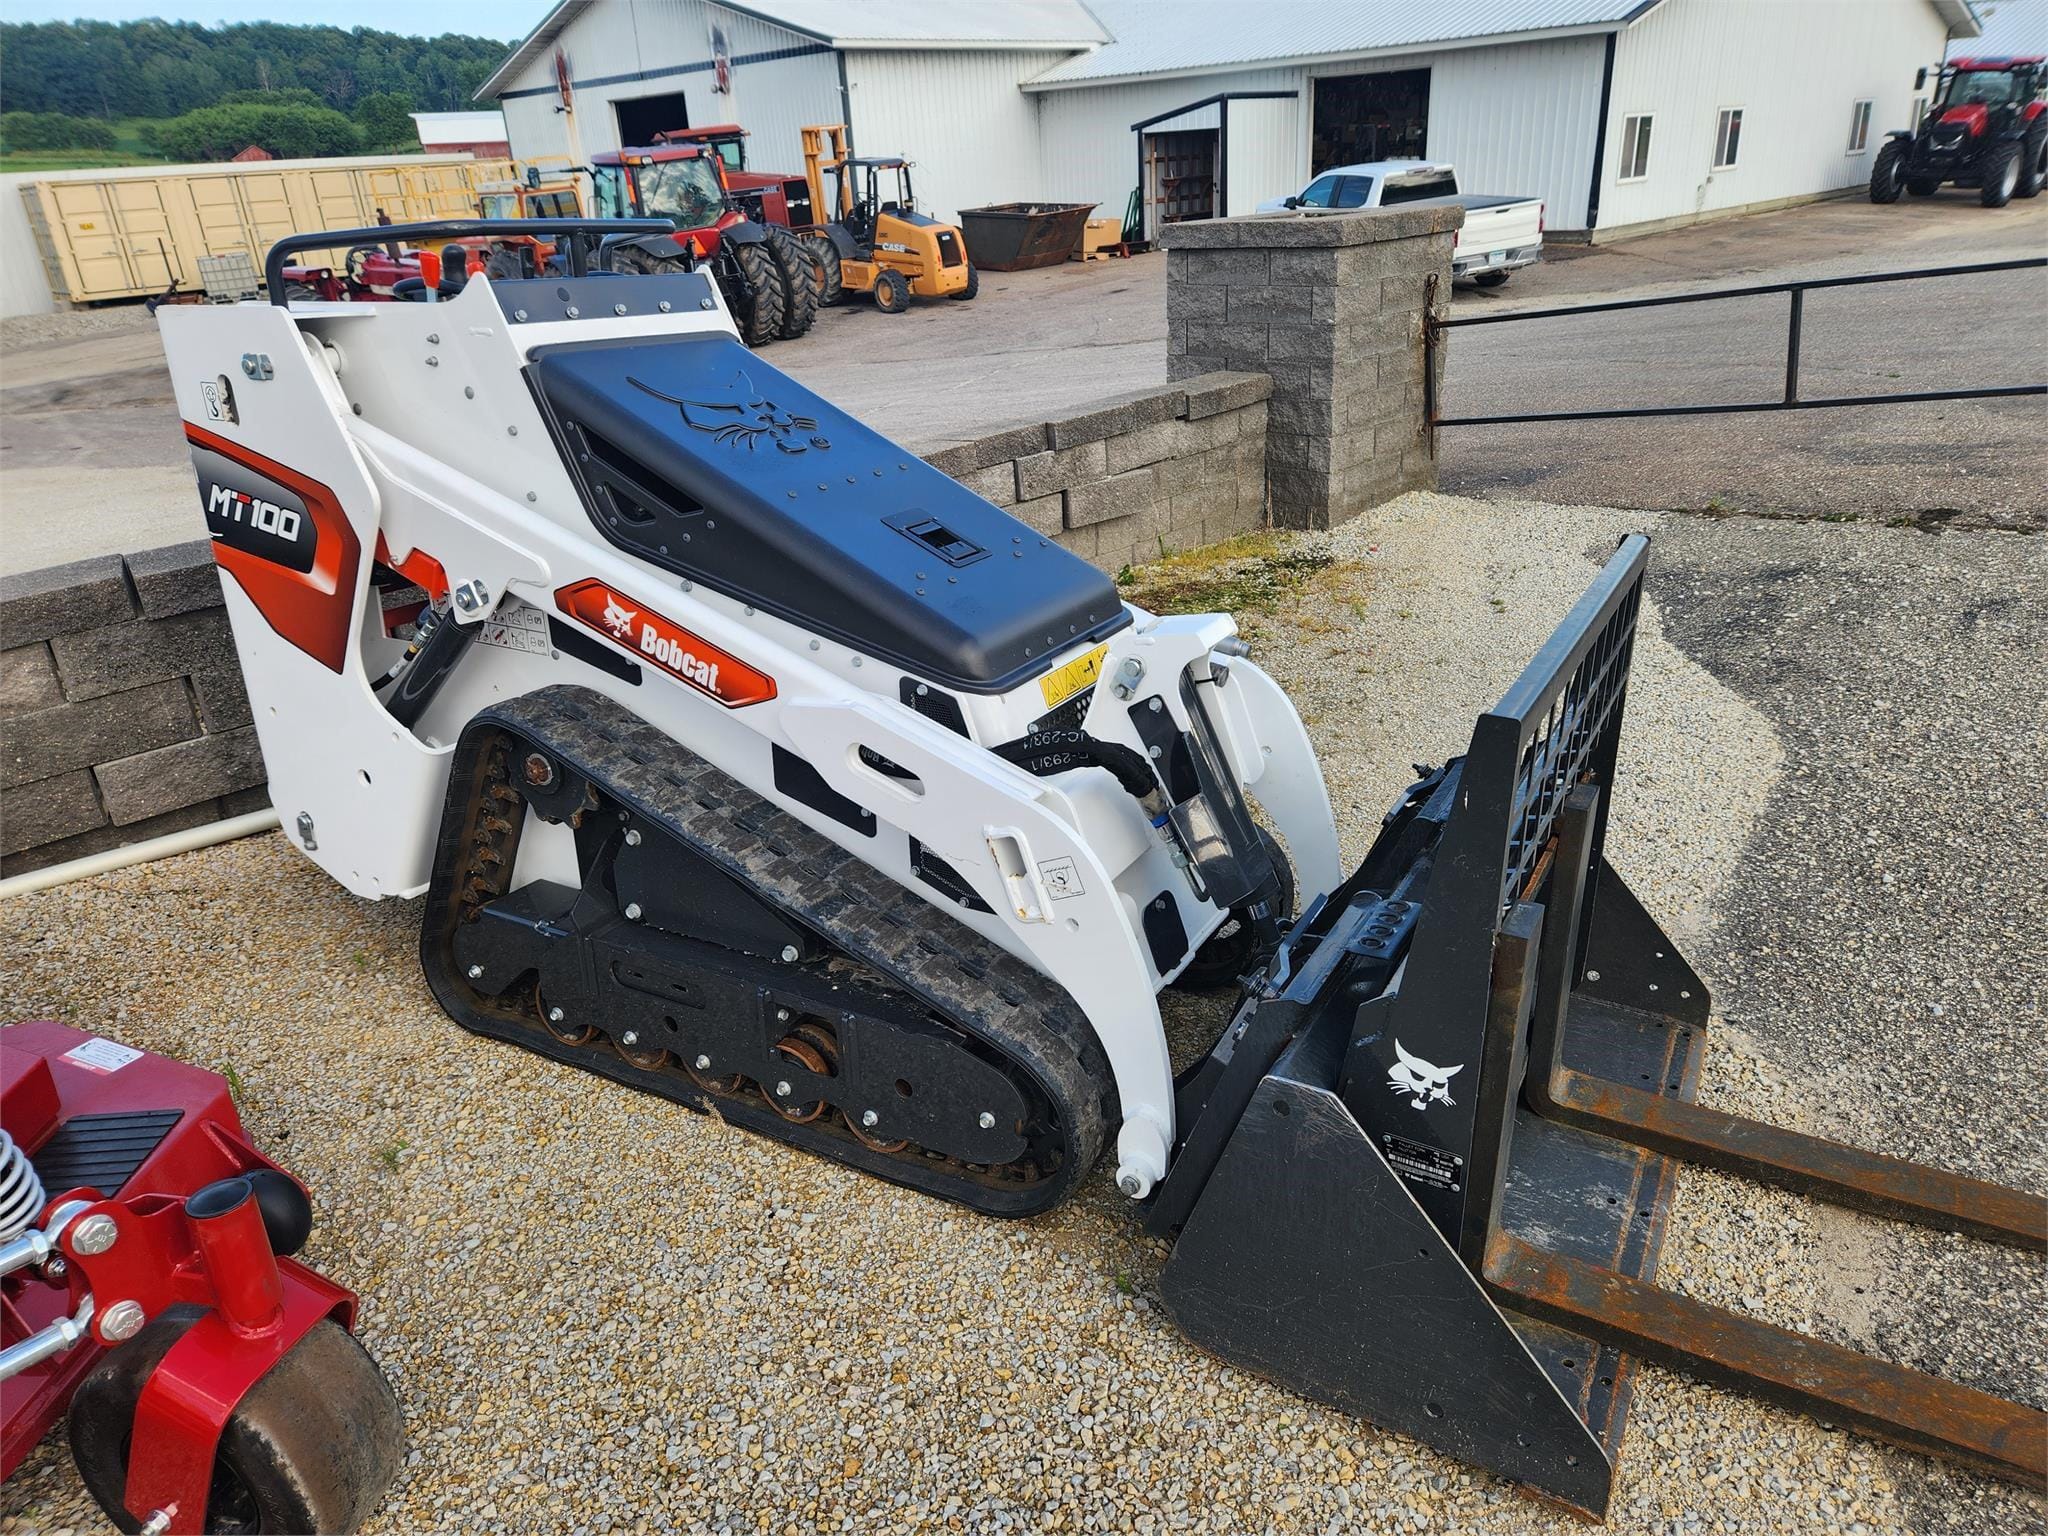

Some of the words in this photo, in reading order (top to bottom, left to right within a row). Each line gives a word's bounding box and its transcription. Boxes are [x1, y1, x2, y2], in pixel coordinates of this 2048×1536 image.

[882, 242, 906, 253] CASE
[208, 483, 302, 543] MT100
[640, 622, 720, 692] Bobcat
